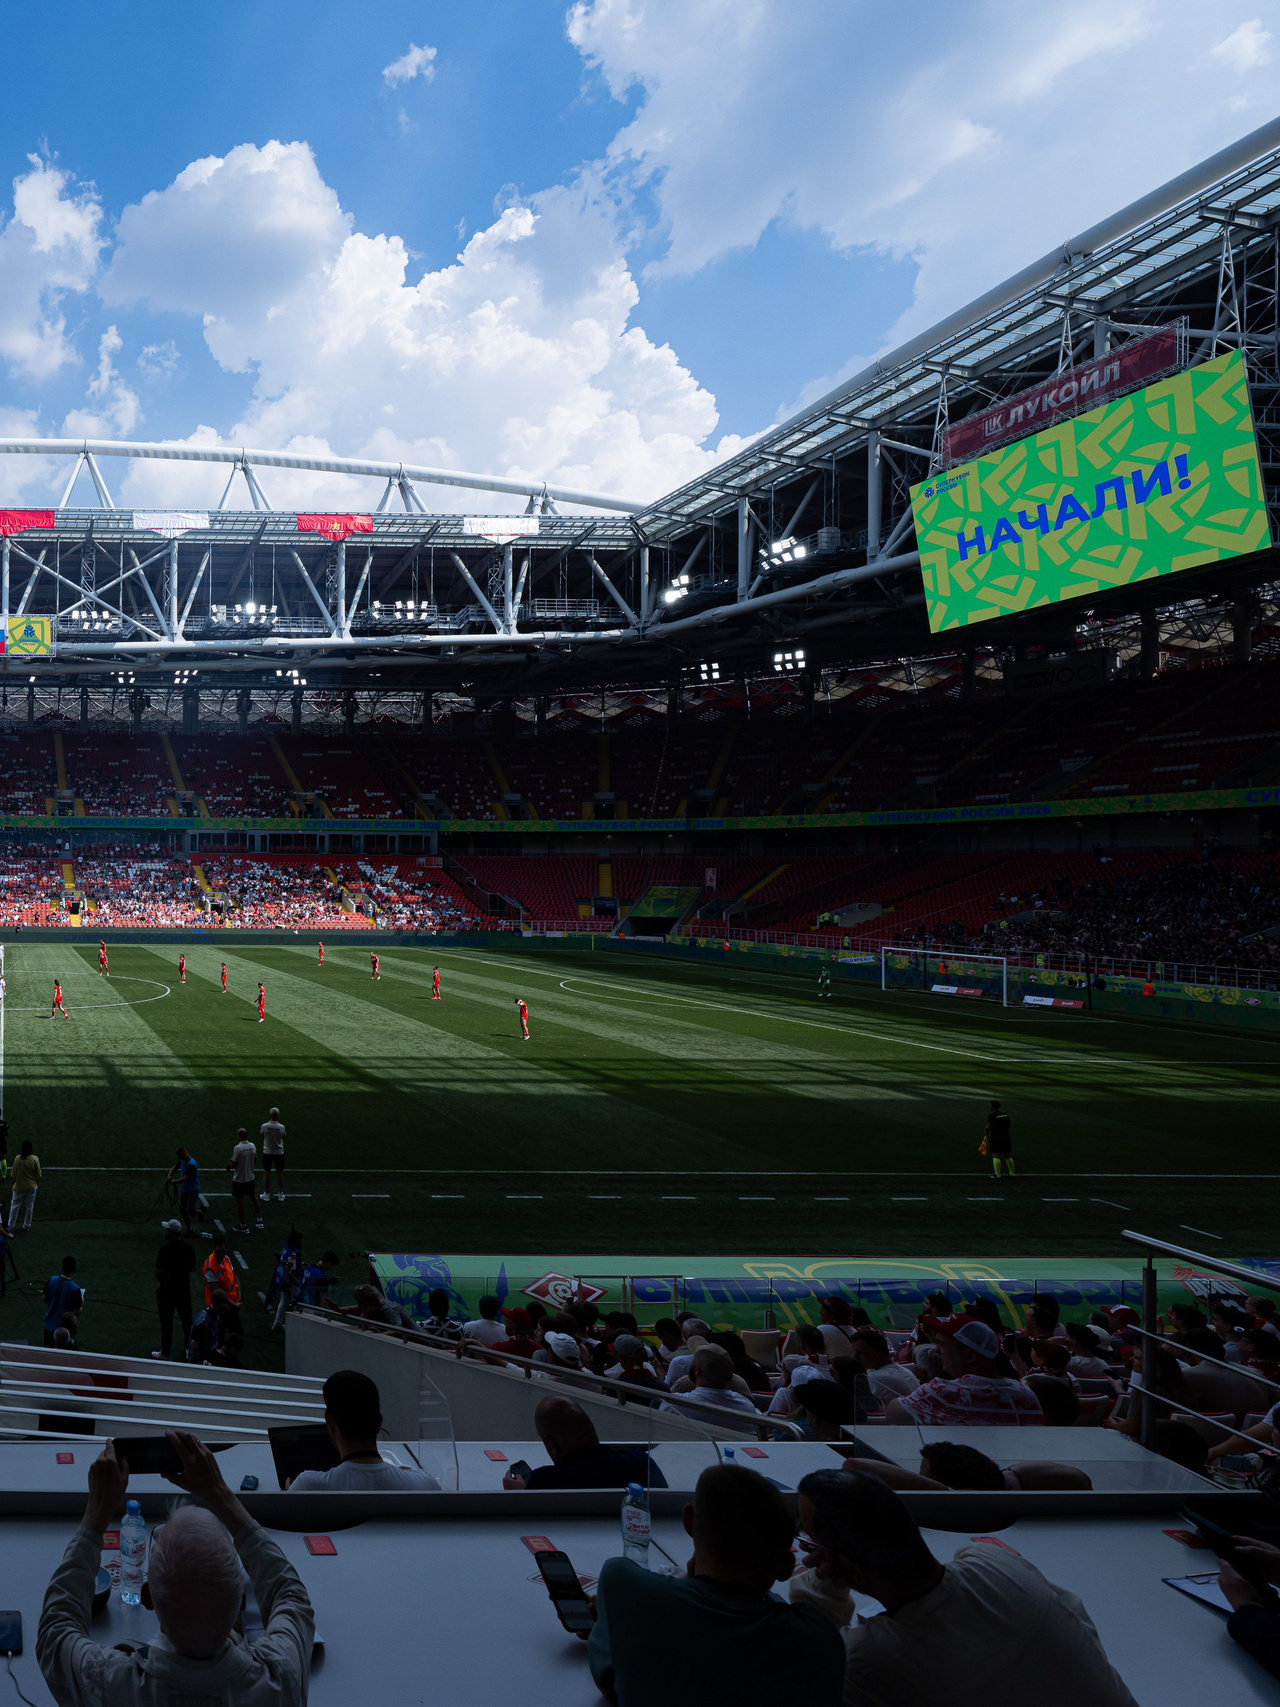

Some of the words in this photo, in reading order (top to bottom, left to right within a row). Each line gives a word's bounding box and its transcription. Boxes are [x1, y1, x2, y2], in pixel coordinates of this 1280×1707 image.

[1006, 361, 1121, 428] ЛУКОЙЛ
[956, 452, 1192, 561] НАЧАЛИ!
[1049, 664, 1097, 685] 100
[870, 809, 958, 823] СУПЕРКУБОК
[960, 806, 1015, 819] РОССИИ
[1019, 804, 1052, 816] 2026
[59, 818, 125, 827] СУПЕРКУБОК
[128, 818, 169, 827] РОССИИ
[172, 819, 195, 827] 2026
[305, 820, 371, 829] СУПЕРКУБОК
[374, 820, 416, 829] РОССИИ
[419, 821, 441, 830] 2026
[558, 820, 637, 830] СУПЕРКУБОК
[640, 819, 691, 829] РОССИИ
[694, 818, 724, 828] 2026
[102, 1532, 118, 1545] 5
